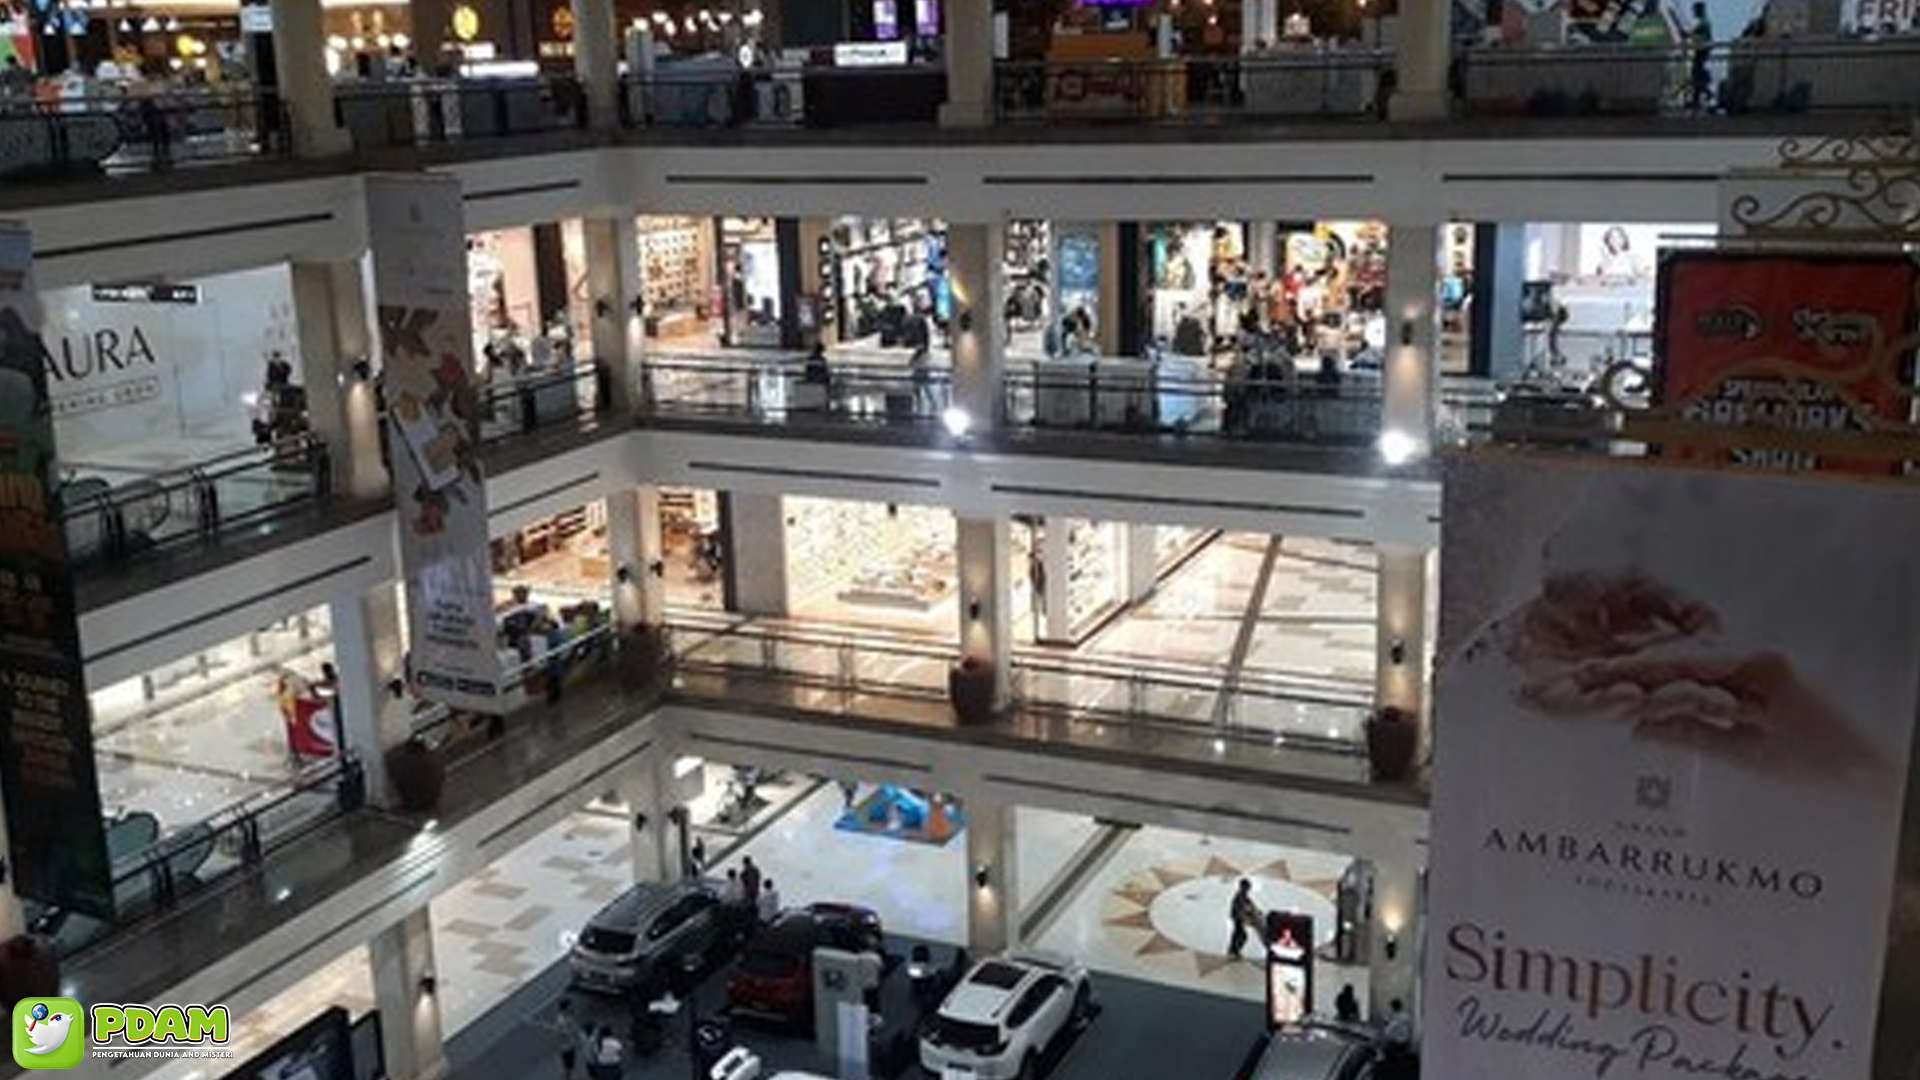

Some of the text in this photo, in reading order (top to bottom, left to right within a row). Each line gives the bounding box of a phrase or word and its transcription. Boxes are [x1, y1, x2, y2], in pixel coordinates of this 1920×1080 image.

[1855, 0, 1920, 19] FRI
[1482, 826, 1825, 900] AMBARRUKMO
[1445, 922, 1845, 1058] Simplicity.
[1456, 995, 1814, 1080] Wedding Packa
